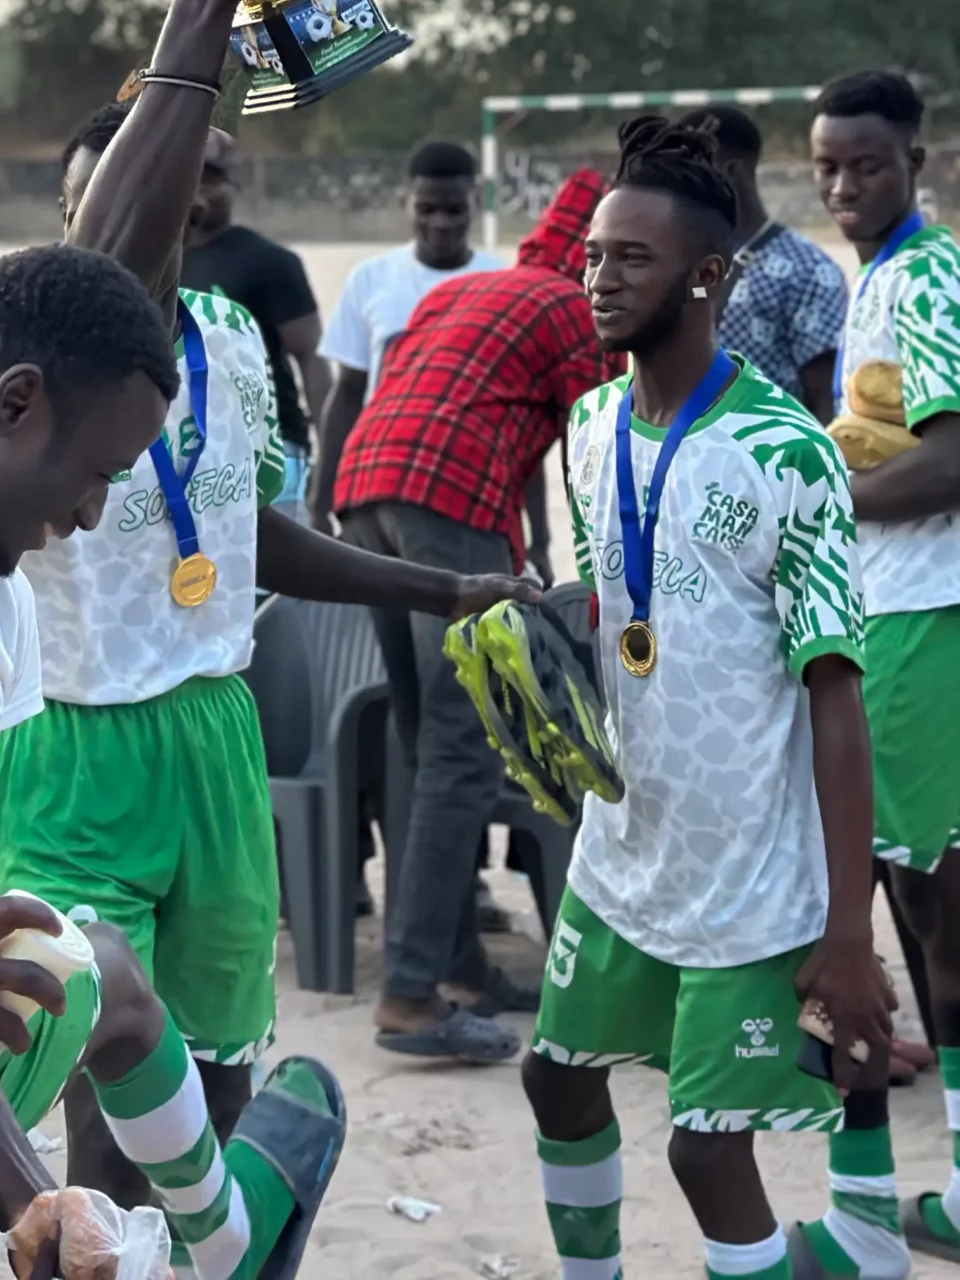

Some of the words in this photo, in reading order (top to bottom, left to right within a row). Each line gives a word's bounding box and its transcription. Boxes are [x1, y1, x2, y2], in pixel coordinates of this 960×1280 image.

[118, 457, 250, 533] SOECA
[707, 490, 759, 525] CASA
[700, 505, 754, 539] MAN
